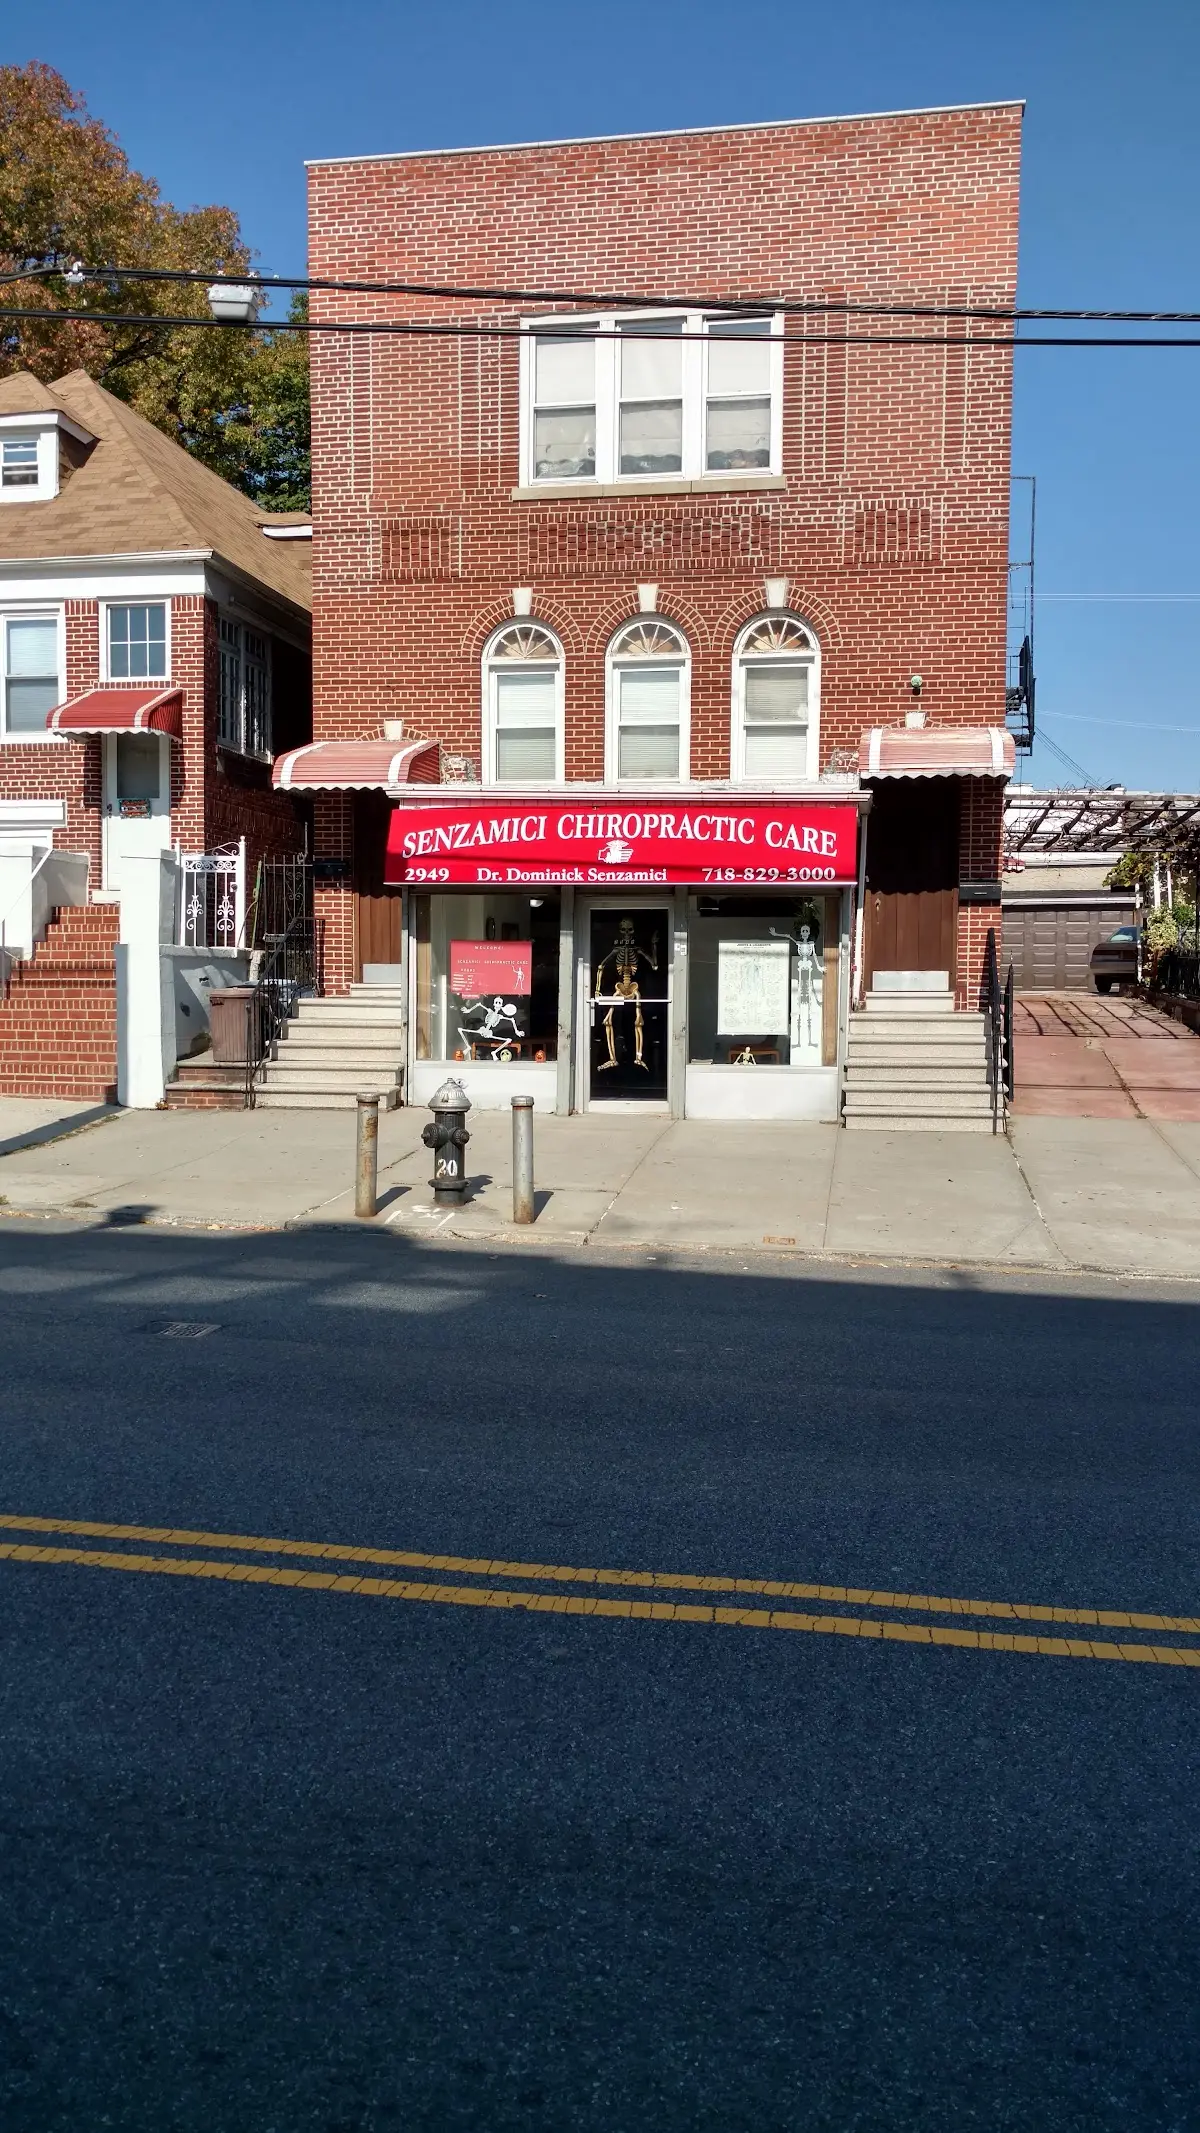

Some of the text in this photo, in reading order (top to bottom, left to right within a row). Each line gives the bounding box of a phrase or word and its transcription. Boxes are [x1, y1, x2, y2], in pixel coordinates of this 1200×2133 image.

[402, 813, 838, 858] SENZAMICI CHIROPRACTIC CARE
[404, 867, 450, 882] 2949
[476, 867, 668, 882] Dr. Dominick Senzamici
[701, 867, 836, 882] 718-829-3000
[436, 1158, 458, 1178] 20
